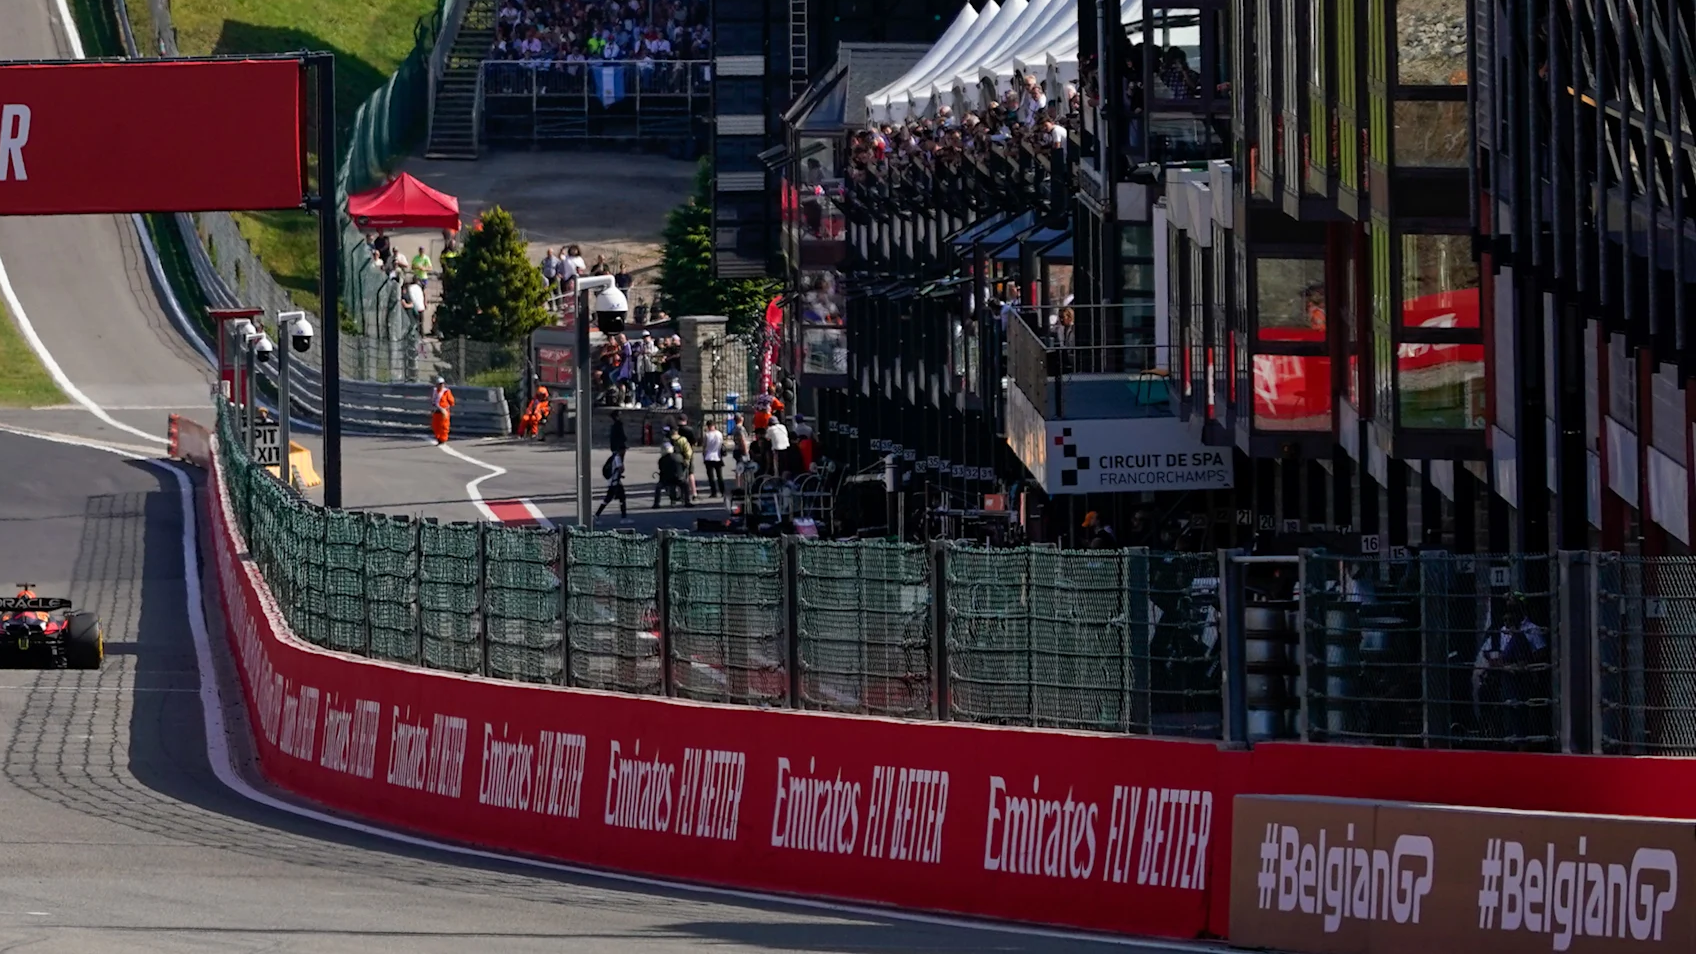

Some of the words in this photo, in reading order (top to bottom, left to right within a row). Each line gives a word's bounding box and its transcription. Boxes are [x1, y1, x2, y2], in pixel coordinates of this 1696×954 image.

[256, 428, 277, 444] PIT
[255, 447, 279, 462] XIT
[929, 457, 939, 467] 35
[1099, 455, 1162, 469] CIRCUIT
[1166, 454, 1187, 467] DE
[1193, 453, 1223, 466] SPA
[953, 466, 963, 476] 33
[966, 467, 977, 478] 32
[981, 468, 992, 478] 31
[1100, 470, 1225, 485] FRANCORCHAMPS
[1238, 511, 1250, 524] 21
[1261, 516, 1274, 528] 20
[1364, 537, 1377, 550] 16
[387, 704, 429, 790] Emirates
[479, 722, 534, 810] Emirates
[533, 730, 554, 814] FLY
[547, 732, 586, 819] BETTER
[604, 738, 675, 832] Emirates
[675, 748, 702, 836] FLY
[696, 749, 745, 841] BETTER
[771, 756, 861, 855] Emirates
[863, 765, 896, 858] FLY
[889, 767, 949, 864] BETTER
[984, 775, 1098, 880] Emirates
[1103, 785, 1142, 883] FLY
[1137, 788, 1213, 890] BETTER
[1258, 823, 1434, 933] #BelgianGP
[1479, 837, 1678, 951] #BelgianGP
